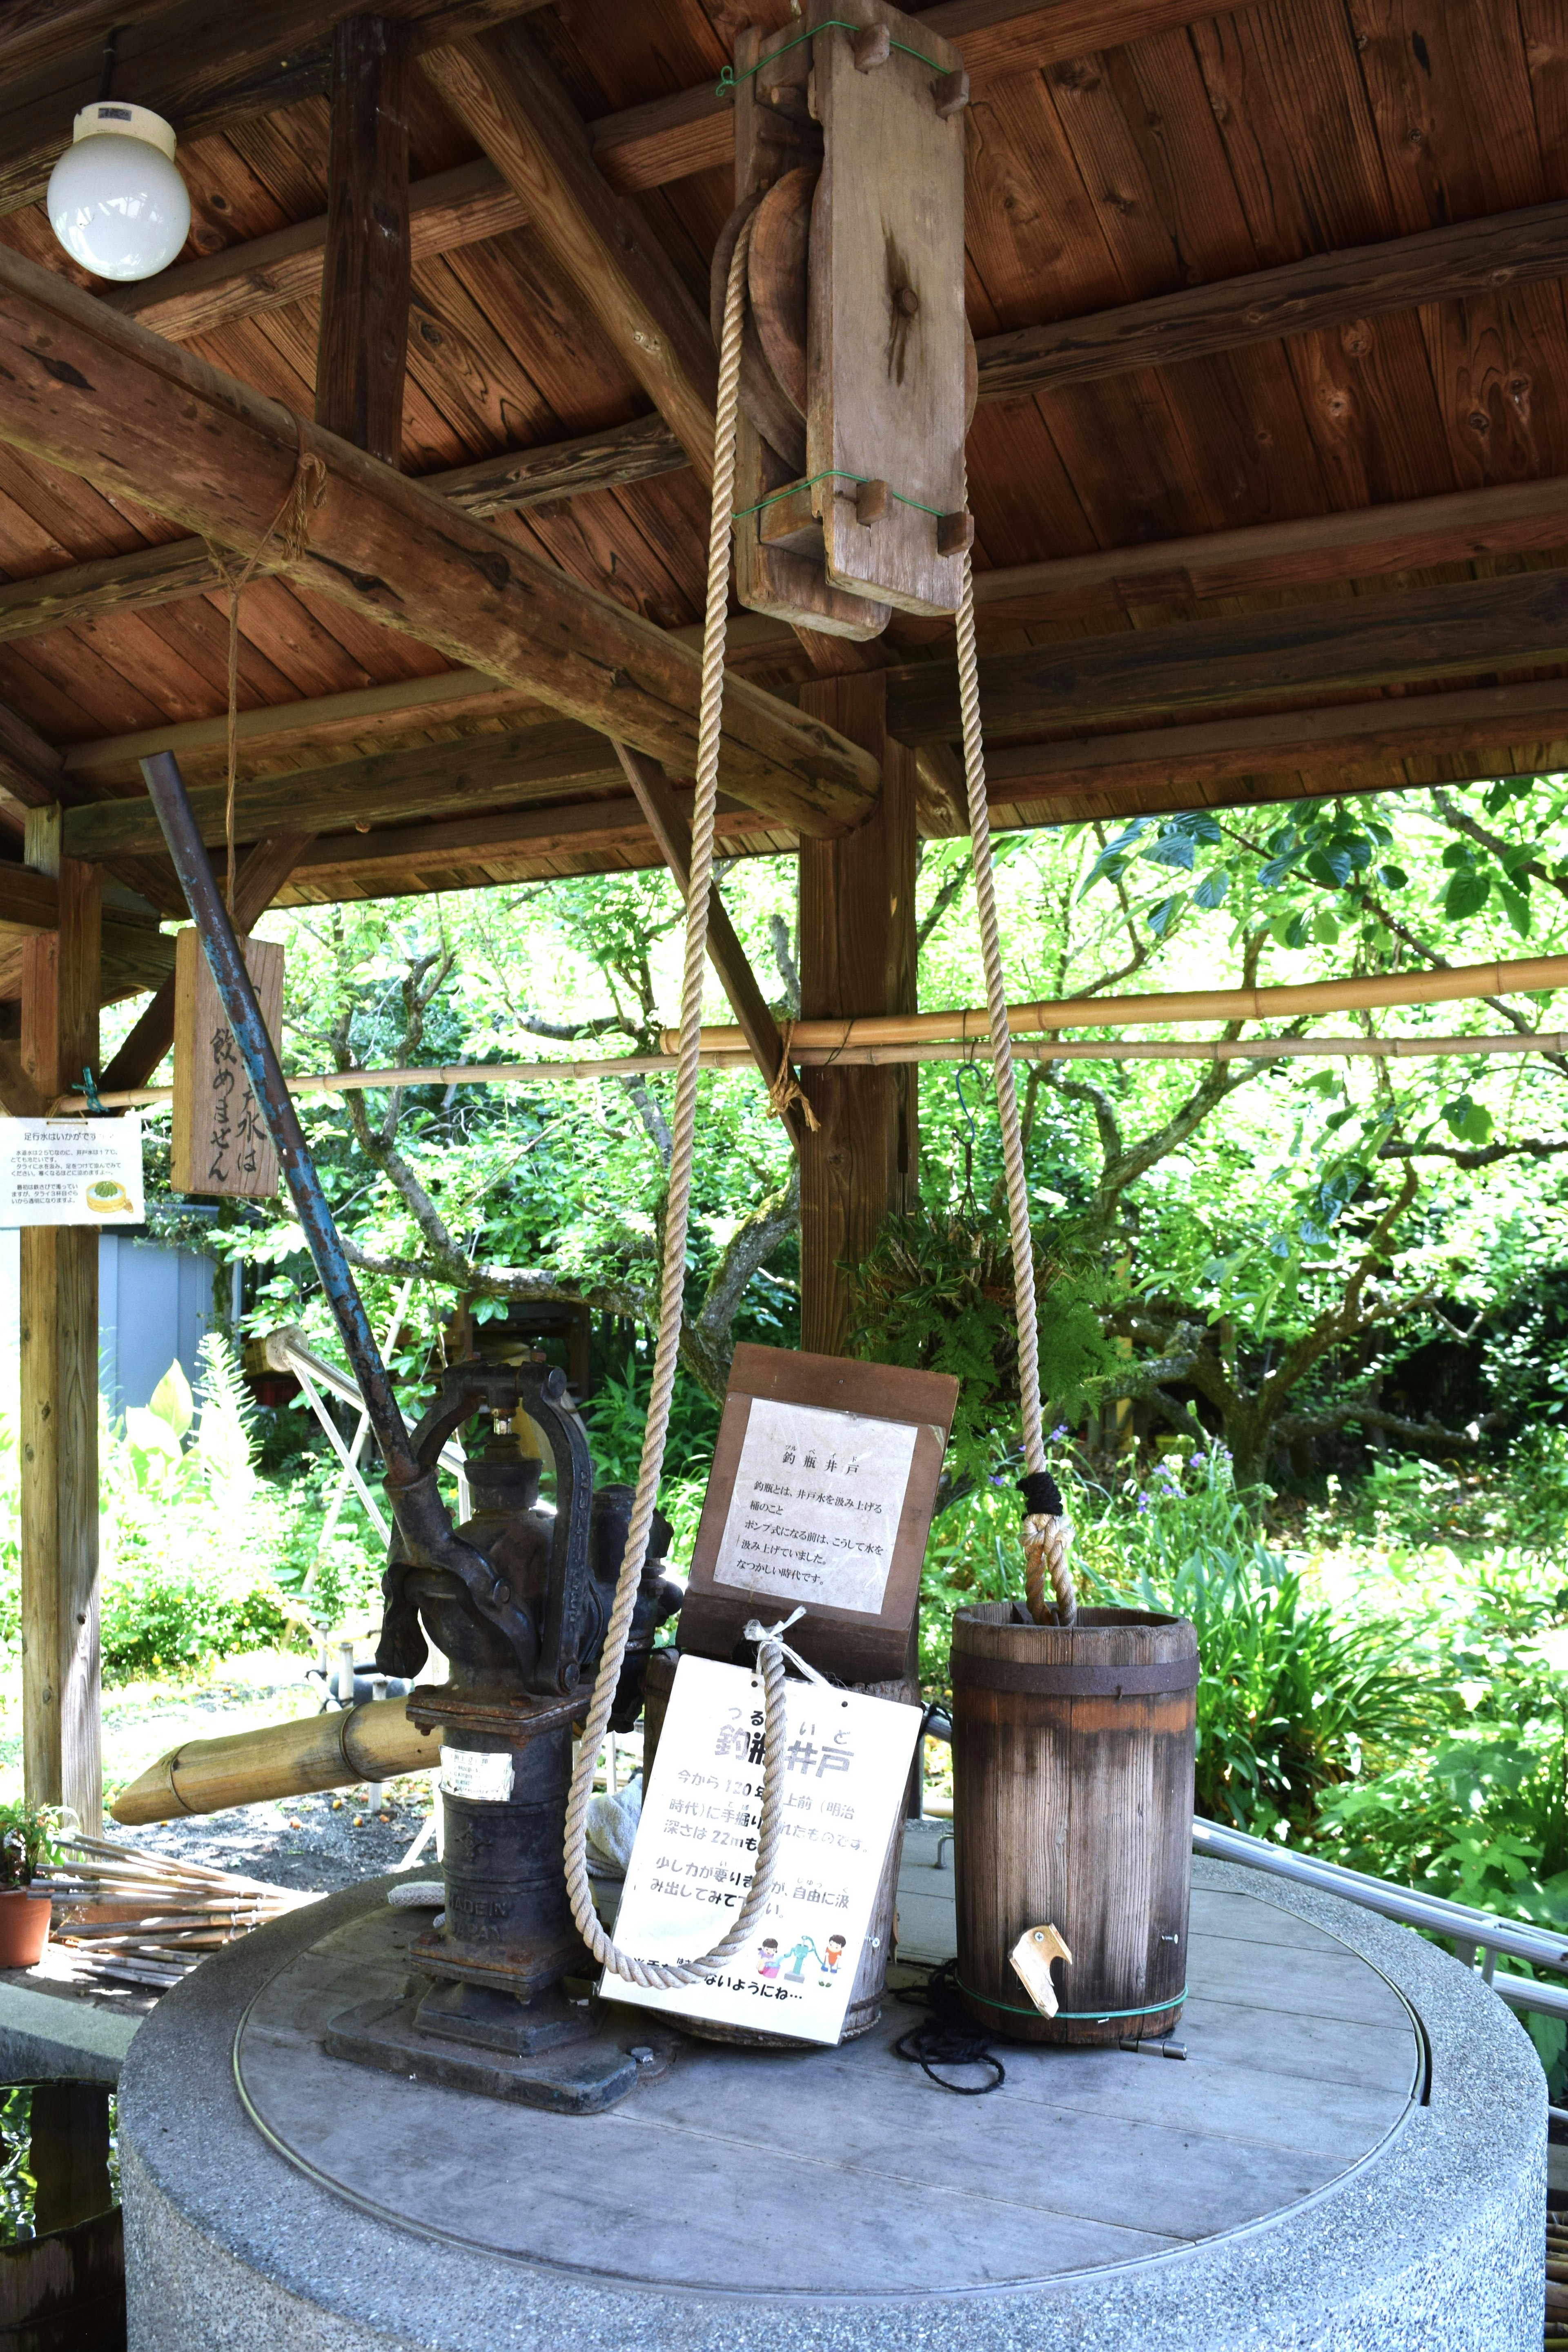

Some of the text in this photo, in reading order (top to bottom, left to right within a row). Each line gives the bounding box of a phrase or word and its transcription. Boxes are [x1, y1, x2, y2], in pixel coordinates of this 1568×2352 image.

[208, 1026, 237, 1183] 飲めません
[749, 1500, 784, 1516] 桶のこと
[753, 1480, 882, 1514] 釣瓶とは、井戸水を汲み上げる
[741, 1539, 827, 1566] 汲み上げていました。
[744, 1520, 884, 1556] ポンプ式になる前は、こうして水を
[736, 1558, 824, 1585] なつかしい時代です。
[650, 1878, 784, 1919] み出してみて下い。
[655, 1856, 850, 1909] 少し力が要りまが、自由に汲
